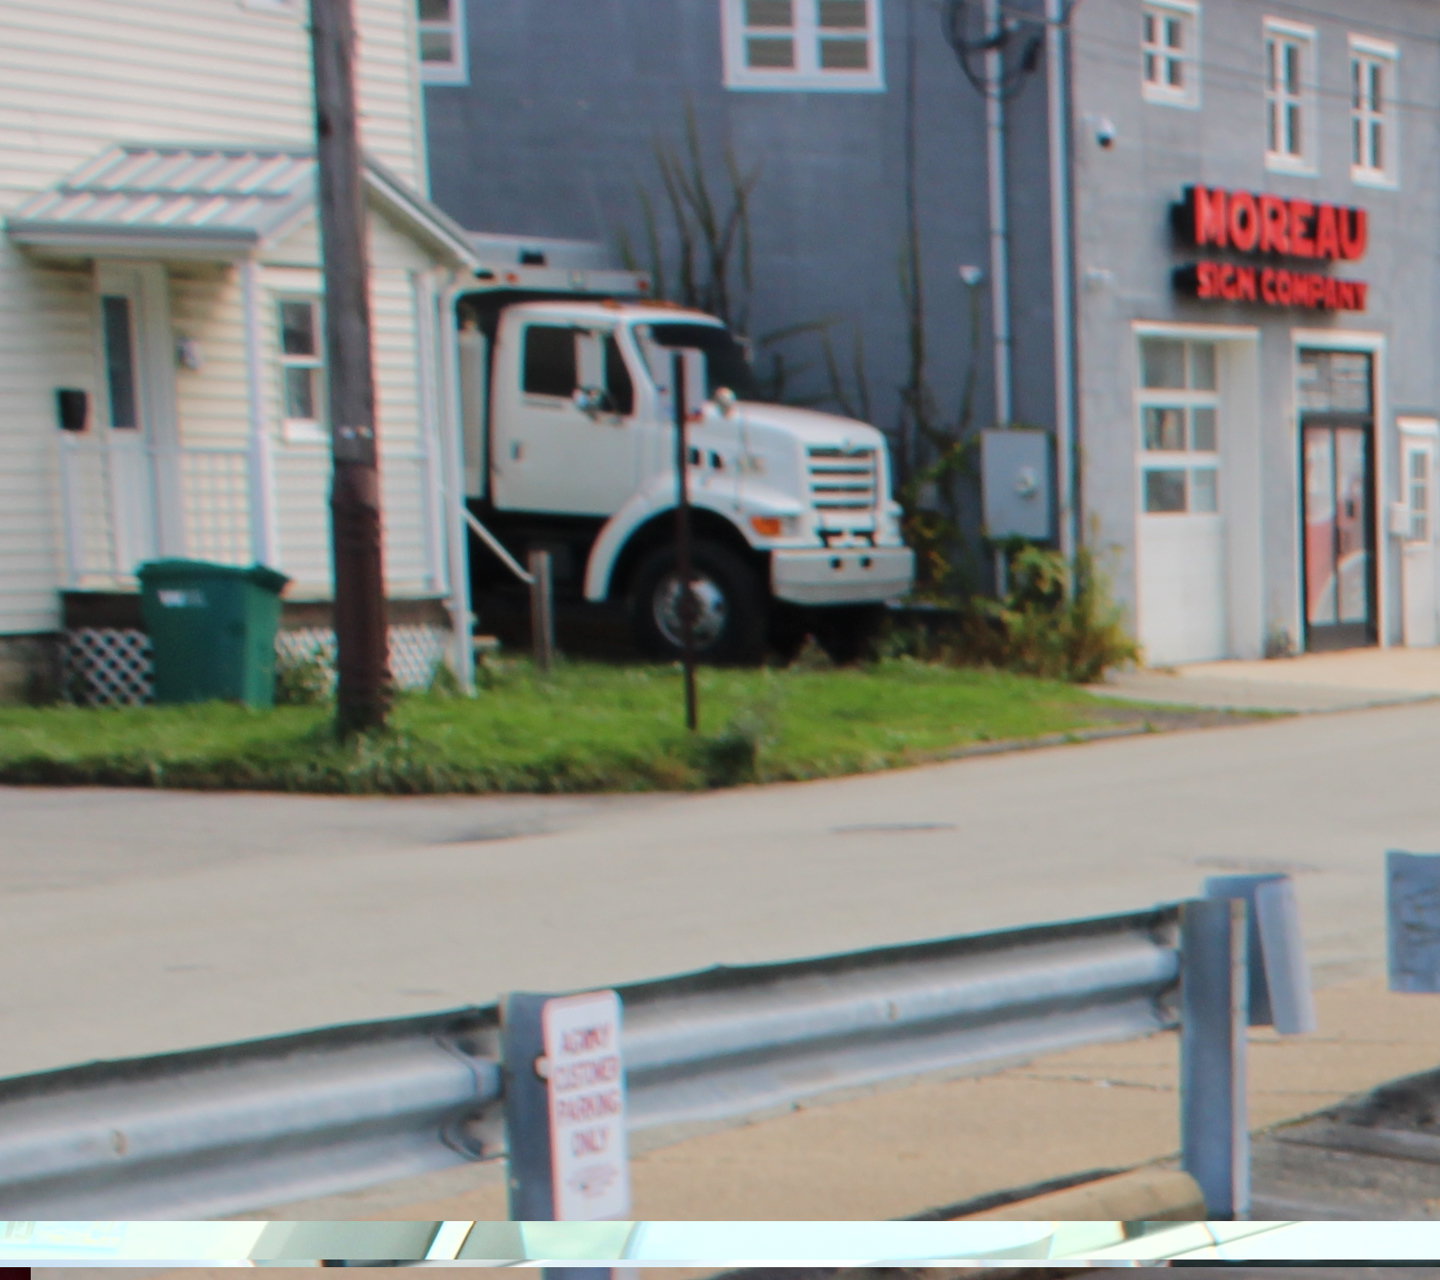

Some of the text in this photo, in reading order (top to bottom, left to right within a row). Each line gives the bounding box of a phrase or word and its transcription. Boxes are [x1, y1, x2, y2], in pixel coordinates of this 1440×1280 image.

[1193, 184, 1367, 260] MOREAU
[1196, 261, 1368, 311] SIGN COMPANY
[556, 1088, 622, 1121] PARKING
[573, 1126, 609, 1158] ONLY
